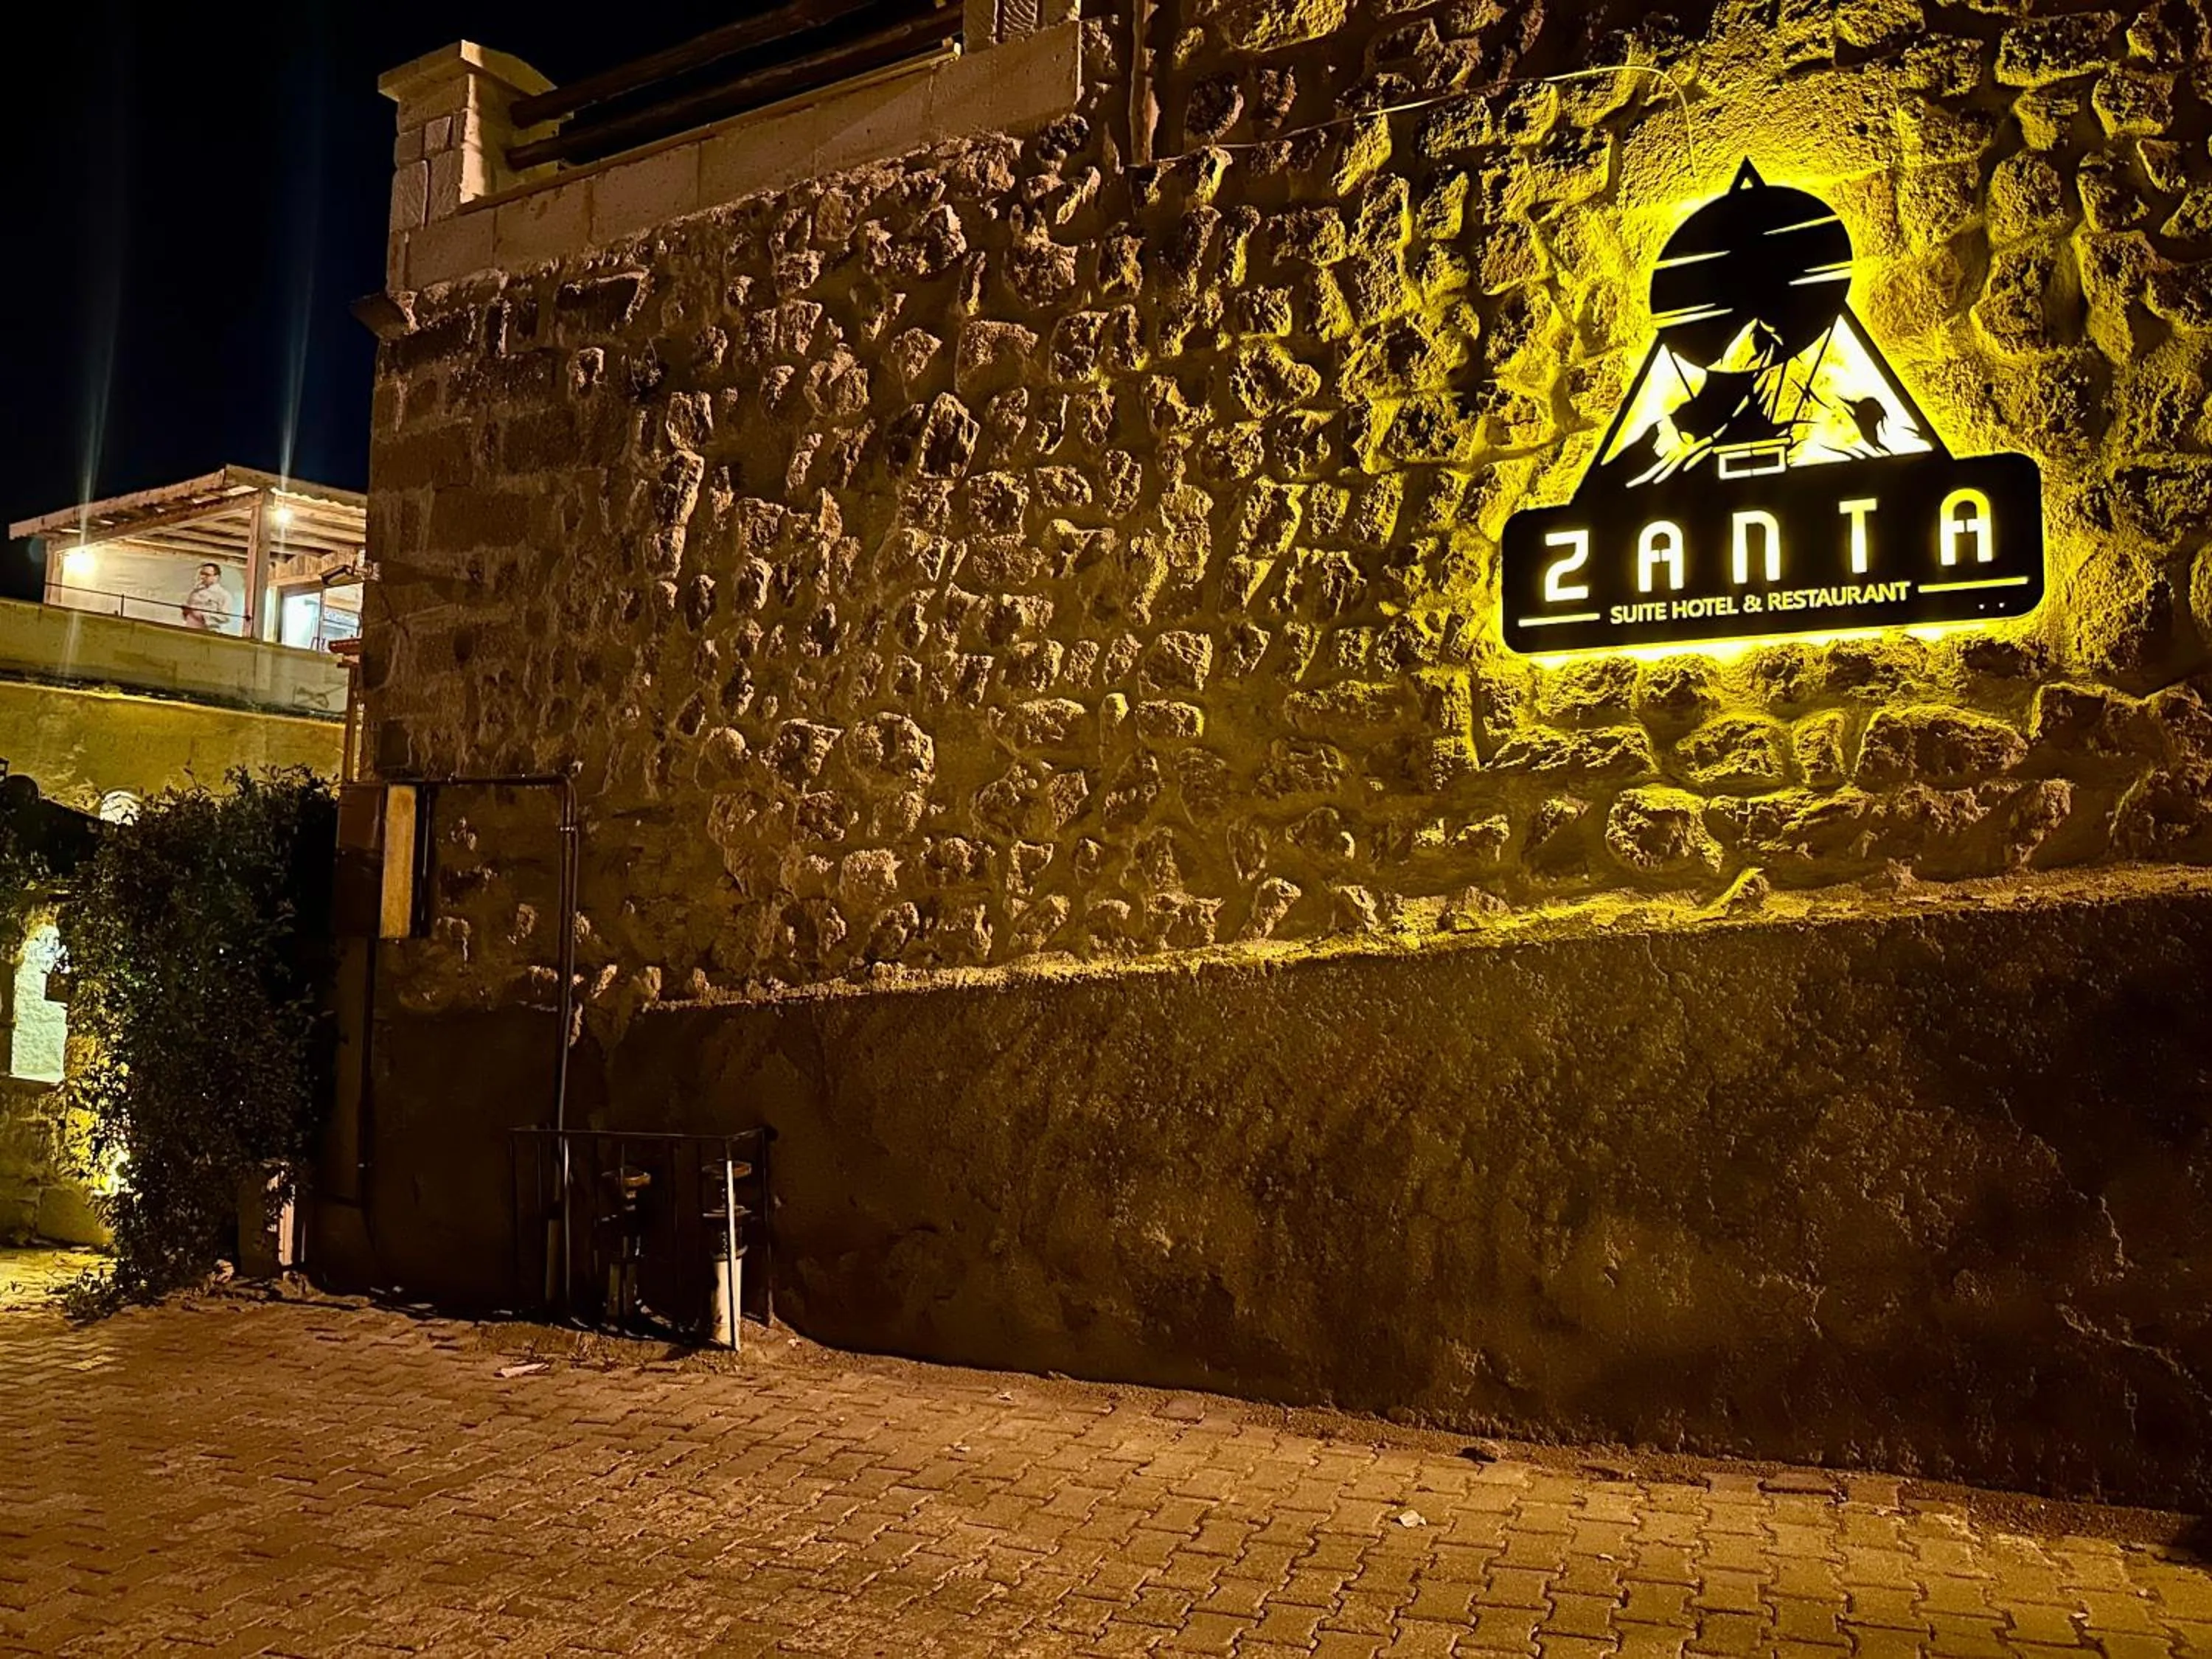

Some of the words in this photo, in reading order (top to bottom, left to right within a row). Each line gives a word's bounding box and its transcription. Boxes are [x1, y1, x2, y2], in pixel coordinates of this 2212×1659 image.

[1544, 488, 1994, 602] ZANTA
[1610, 602, 1667, 625] SUITE
[1672, 596, 1739, 619] HOTEL
[1742, 594, 1763, 613] &
[1767, 581, 1911, 611] RESTAURANT
